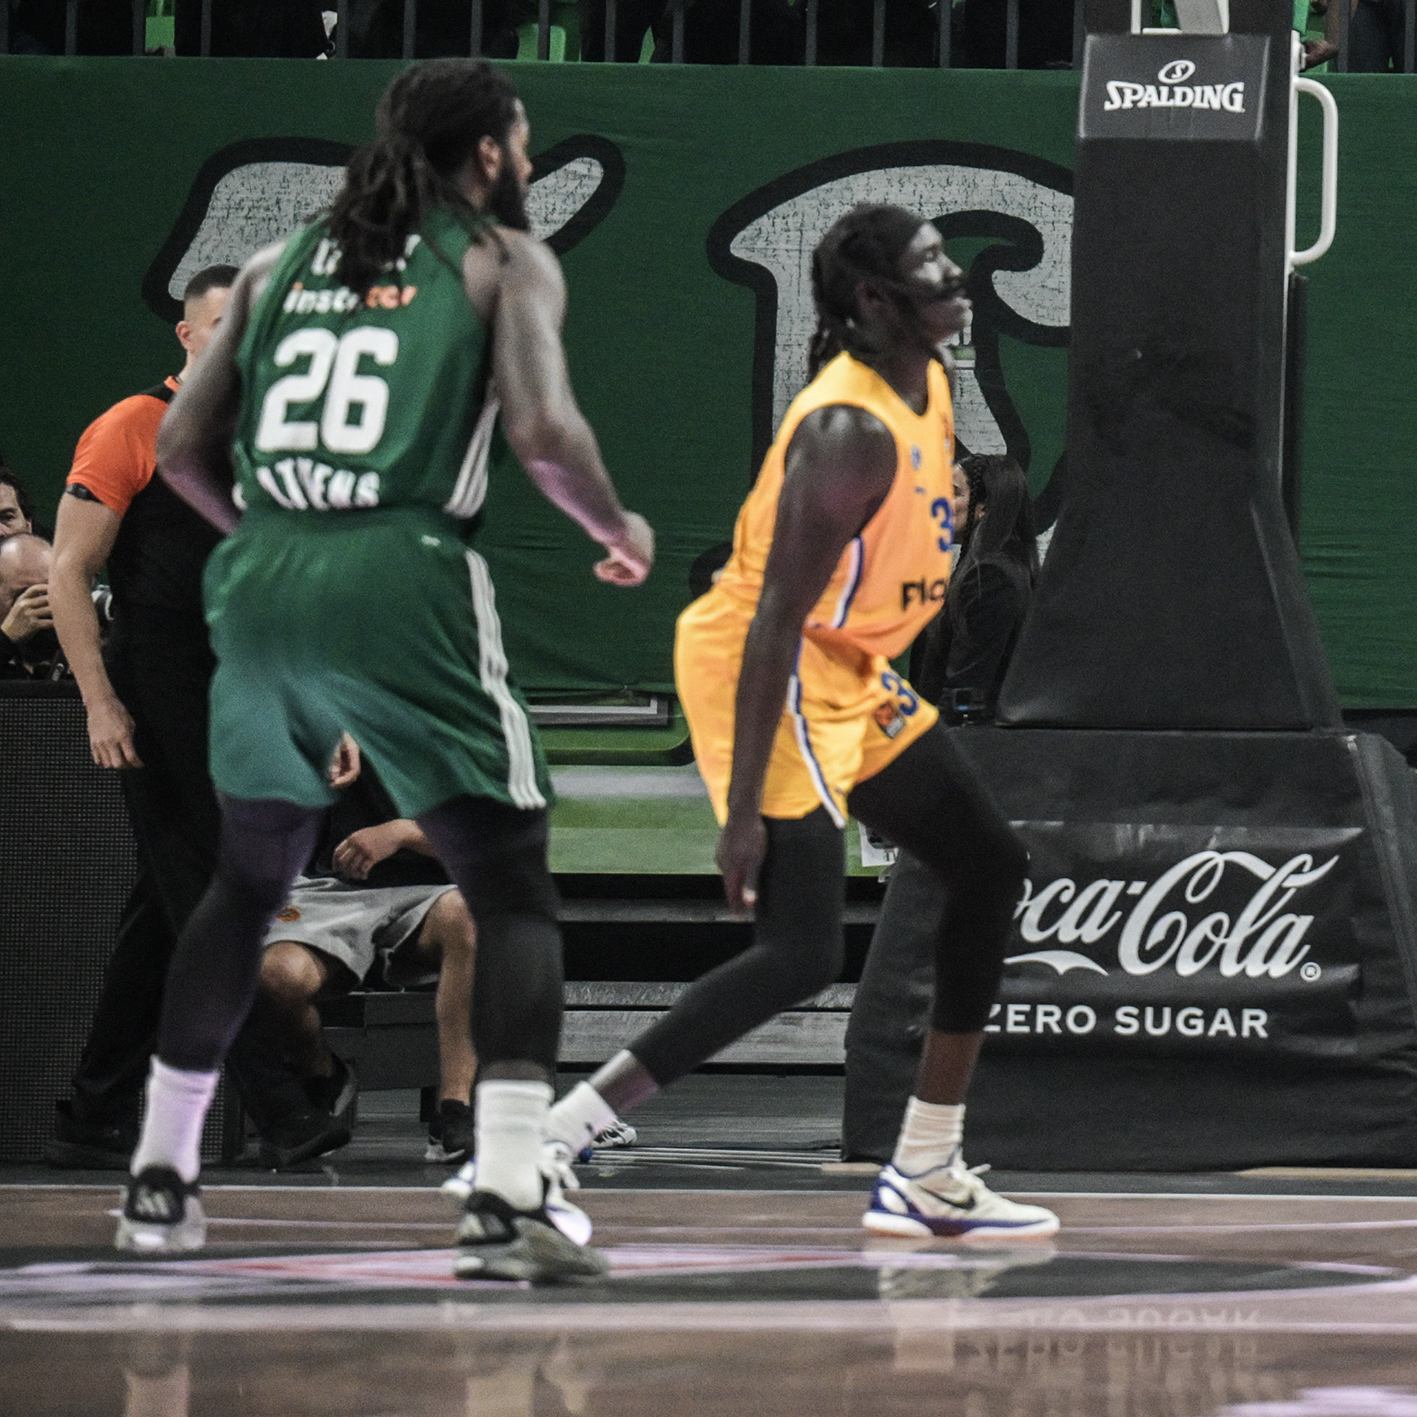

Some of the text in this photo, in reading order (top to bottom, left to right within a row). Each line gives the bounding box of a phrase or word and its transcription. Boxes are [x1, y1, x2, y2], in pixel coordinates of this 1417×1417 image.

[1104, 79, 1245, 114] SPALDING
[255, 326, 399, 454] 26
[1113, 1003, 1270, 1039] SUGAR
